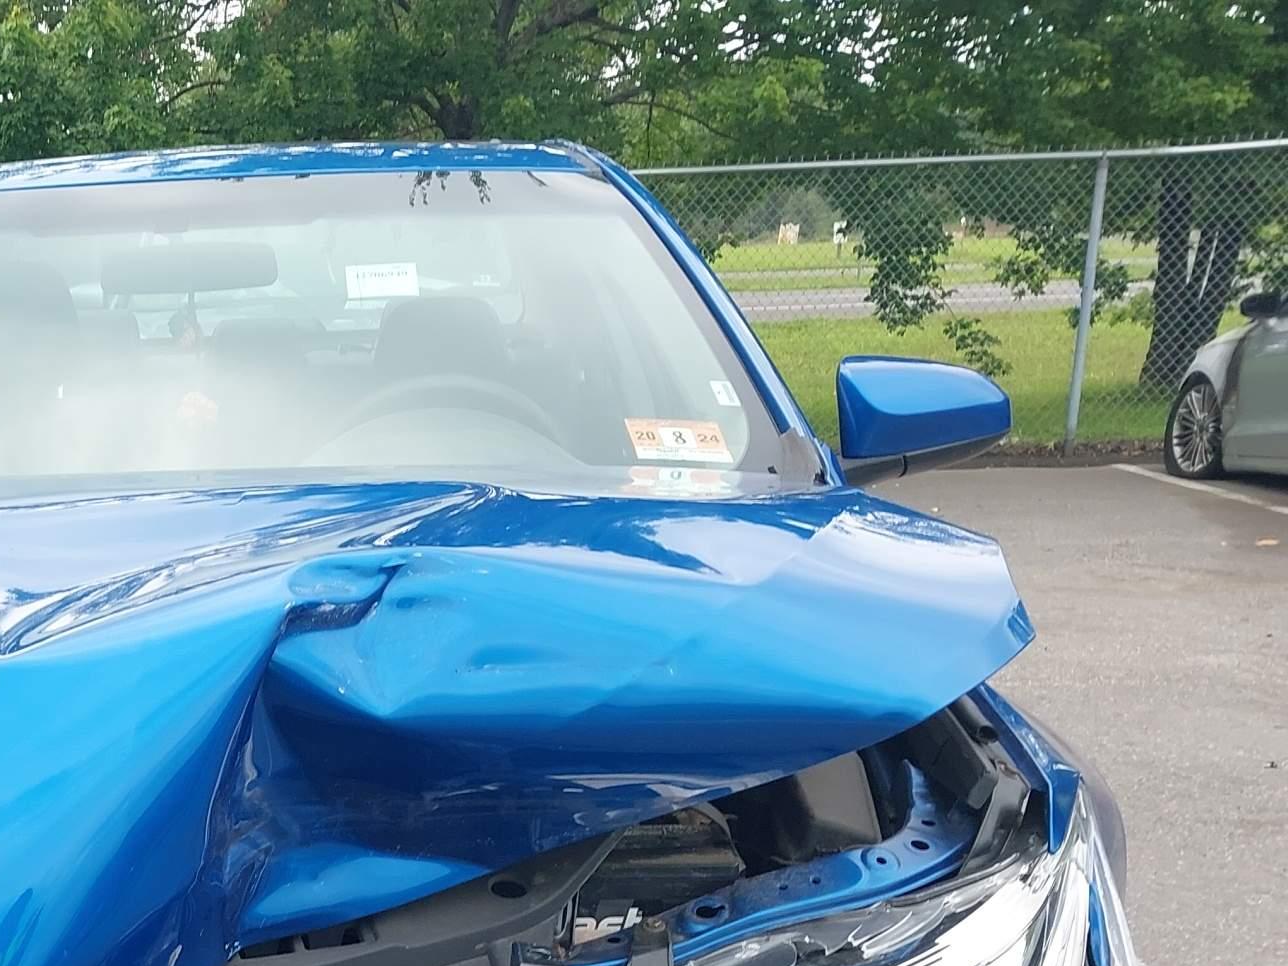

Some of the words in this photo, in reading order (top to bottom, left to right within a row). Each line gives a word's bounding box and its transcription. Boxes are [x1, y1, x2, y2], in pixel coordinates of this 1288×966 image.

[635, 431, 656, 441] 20
[673, 430, 687, 445] 8
[697, 433, 720, 444] 24
